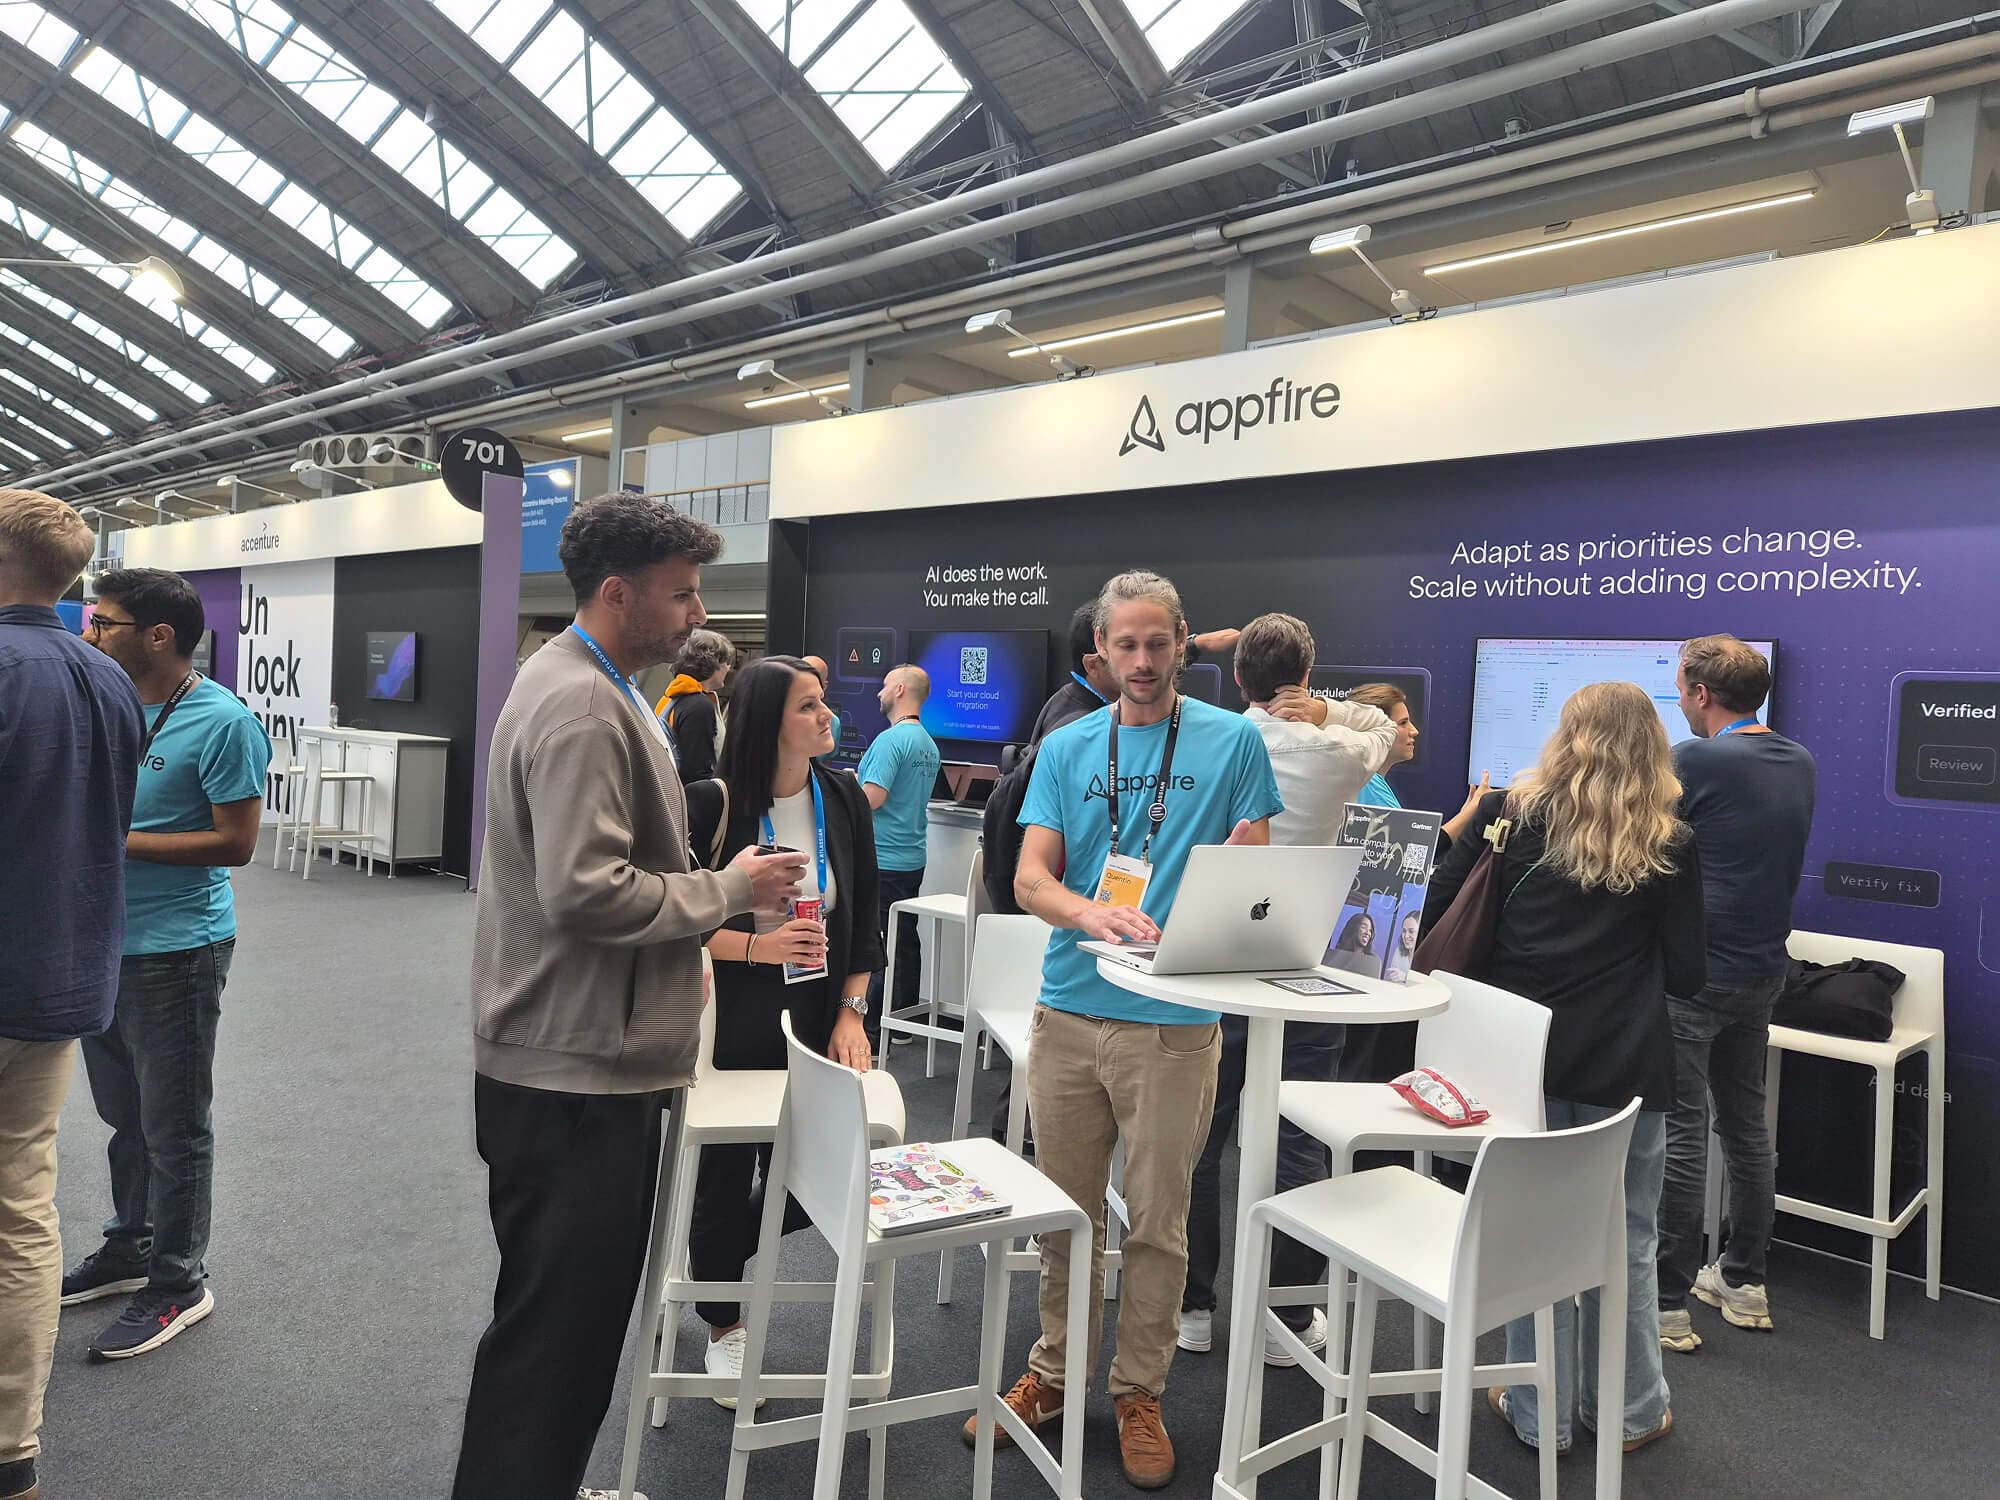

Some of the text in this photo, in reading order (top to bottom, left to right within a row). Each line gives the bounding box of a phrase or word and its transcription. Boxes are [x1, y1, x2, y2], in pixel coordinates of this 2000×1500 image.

[1175, 377, 1340, 444] appfire
[462, 438, 505, 466] 701
[241, 533, 280, 552] accenture
[1451, 526, 1862, 568] Adapt as priorities change.
[926, 561, 1048, 583] AI does the work.
[1408, 560, 1922, 599] Scale without adding complexity.
[923, 586, 1049, 607] You make the call.
[240, 584, 268, 635] Un
[248, 639, 301, 698] lock
[946, 689, 1000, 700] Start your cloud
[956, 701, 989, 711] migration
[1921, 703, 1997, 719] Verified
[1930, 758, 1983, 771] Review
[1116, 773, 1195, 796] appire
[1344, 834, 1359, 843] Turn
[1359, 860, 1378, 868] eams
[1376, 851, 1395, 860] work
[1841, 875, 1921, 893] Verify fix
